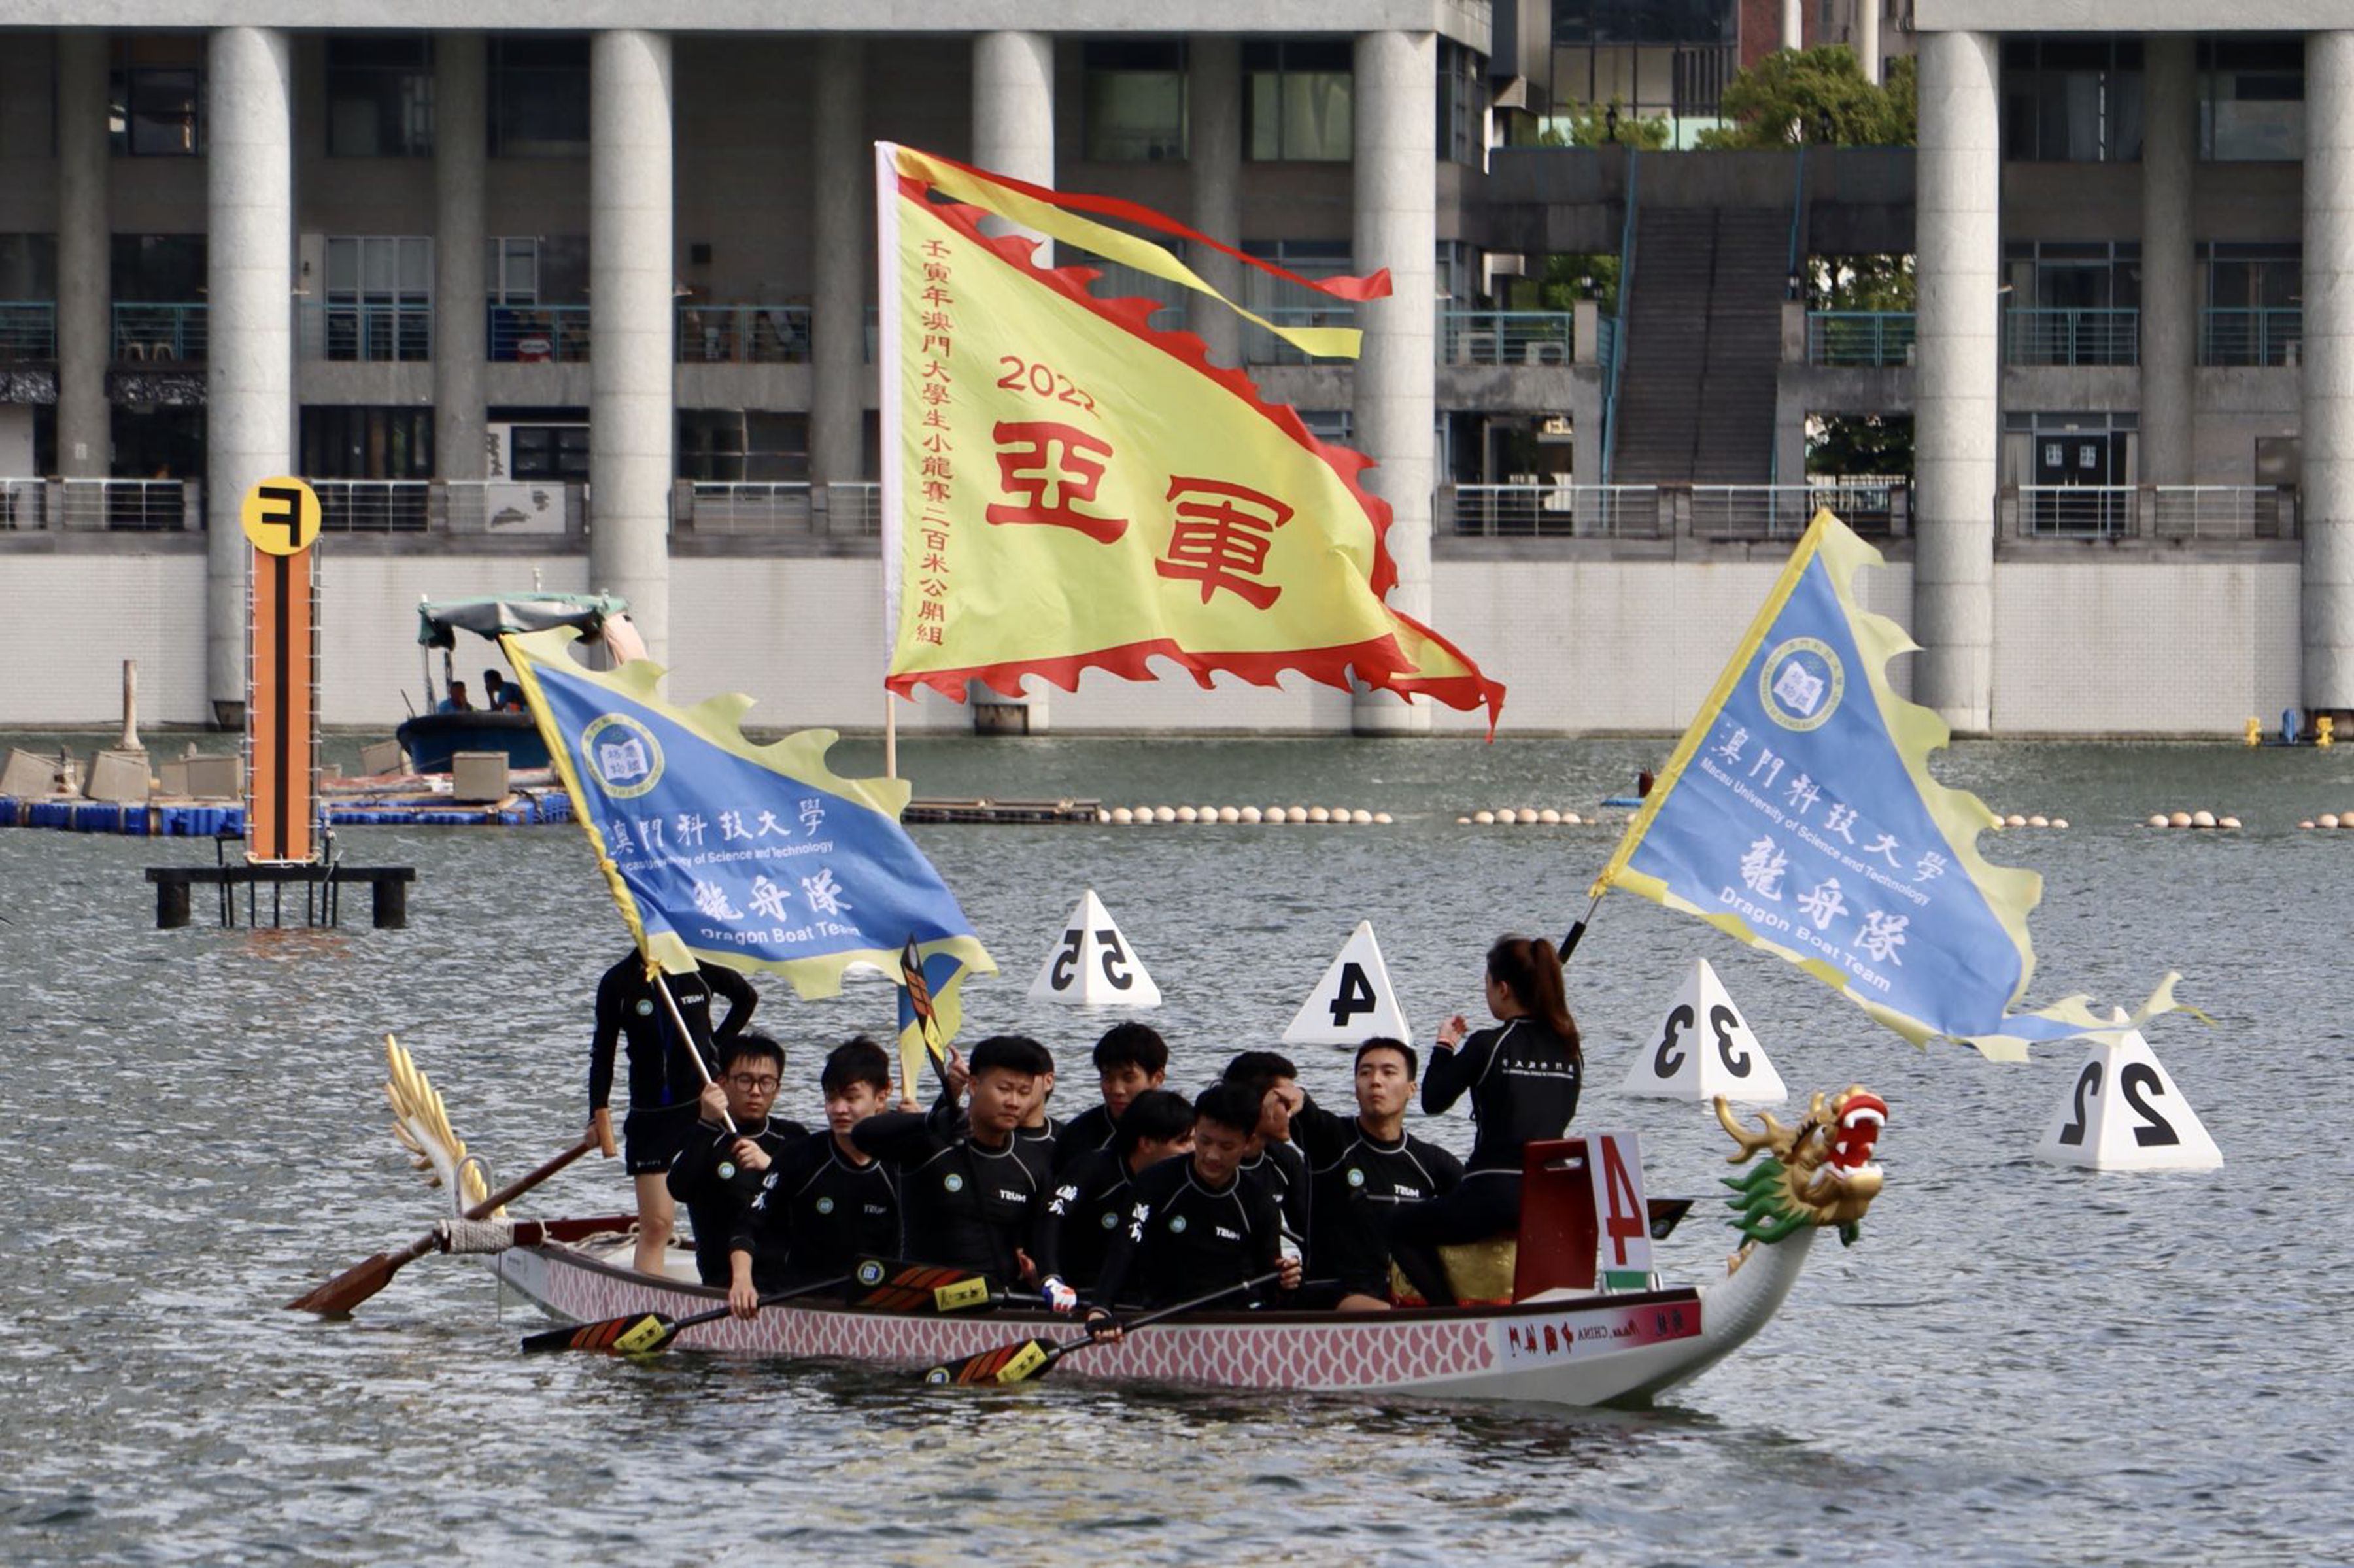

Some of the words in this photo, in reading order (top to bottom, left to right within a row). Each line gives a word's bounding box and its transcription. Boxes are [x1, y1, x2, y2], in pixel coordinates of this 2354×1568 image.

[997, 356, 1102, 420] 2022
[986, 420, 1294, 610] 亞軍
[610, 798, 826, 856] 澳門科技大學
[1701, 757, 1733, 787] Macau
[1734, 781, 1786, 824] University
[1784, 819, 1798, 831] of
[1798, 825, 1841, 859] Science
[1841, 855, 1866, 873] and
[1866, 865, 1930, 907] Technology
[1711, 723, 1948, 883] 澳門科技大學
[694, 853, 706, 865] of
[708, 850, 752, 863] Science
[771, 841, 834, 858] Technology
[694, 867, 852, 922] 龍舟隊
[700, 928, 769, 946] Dragon
[772, 926, 815, 943] Boat
[816, 921, 861, 937] Team
[1720, 886, 1790, 932] Dragon
[1796, 926, 1841, 959] Boat
[1844, 952, 1891, 992] Team
[1740, 835, 1910, 966] 龍舟隊
